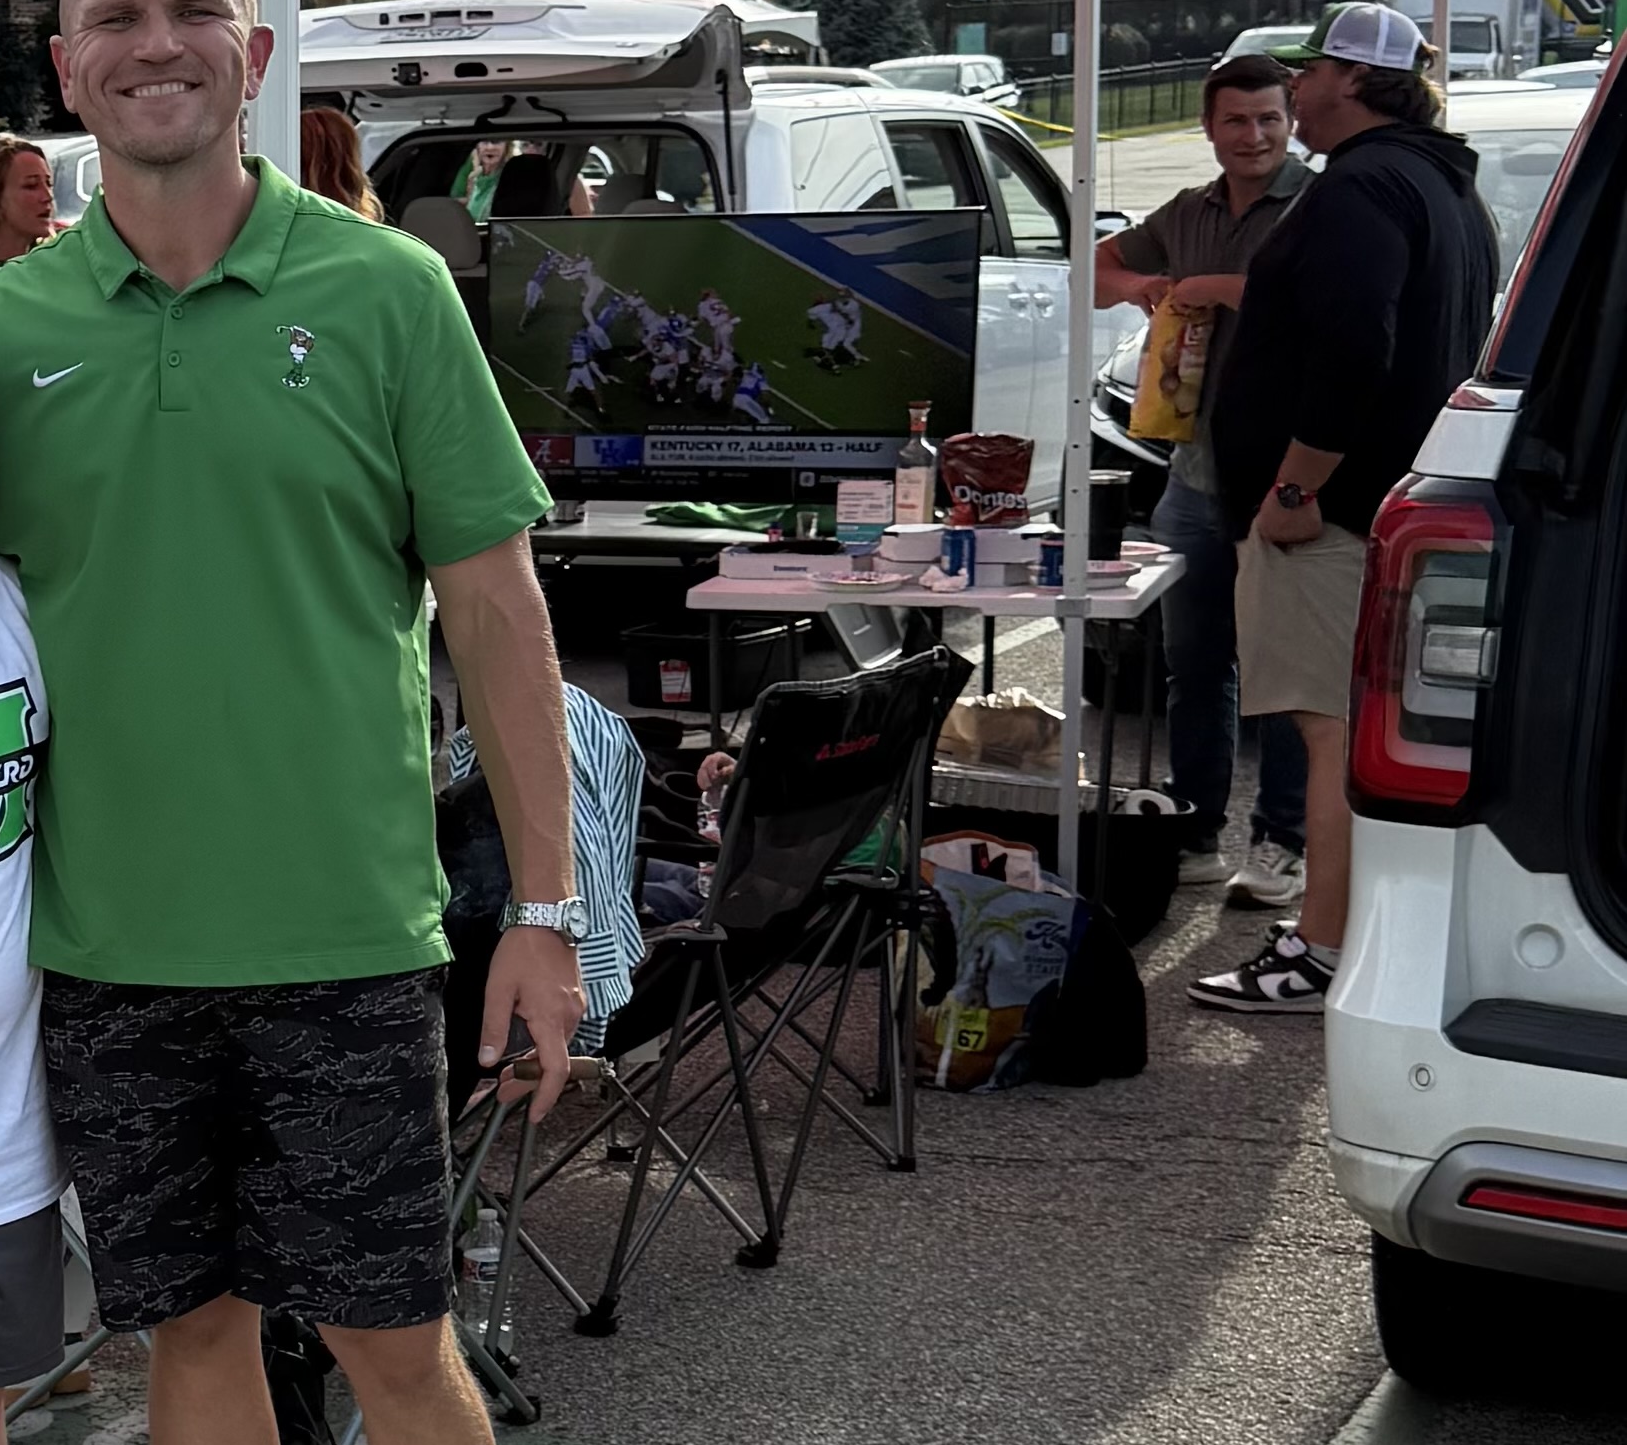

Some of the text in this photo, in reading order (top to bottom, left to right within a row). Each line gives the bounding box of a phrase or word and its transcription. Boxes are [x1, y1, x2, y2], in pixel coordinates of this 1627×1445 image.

[649, 440, 723, 452] KENTUCKY
[747, 441, 816, 453] ALABAMA
[846, 441, 884, 453] HALF
[954, 485, 1027, 509] Doritos
[958, 1029, 984, 1048] 67
